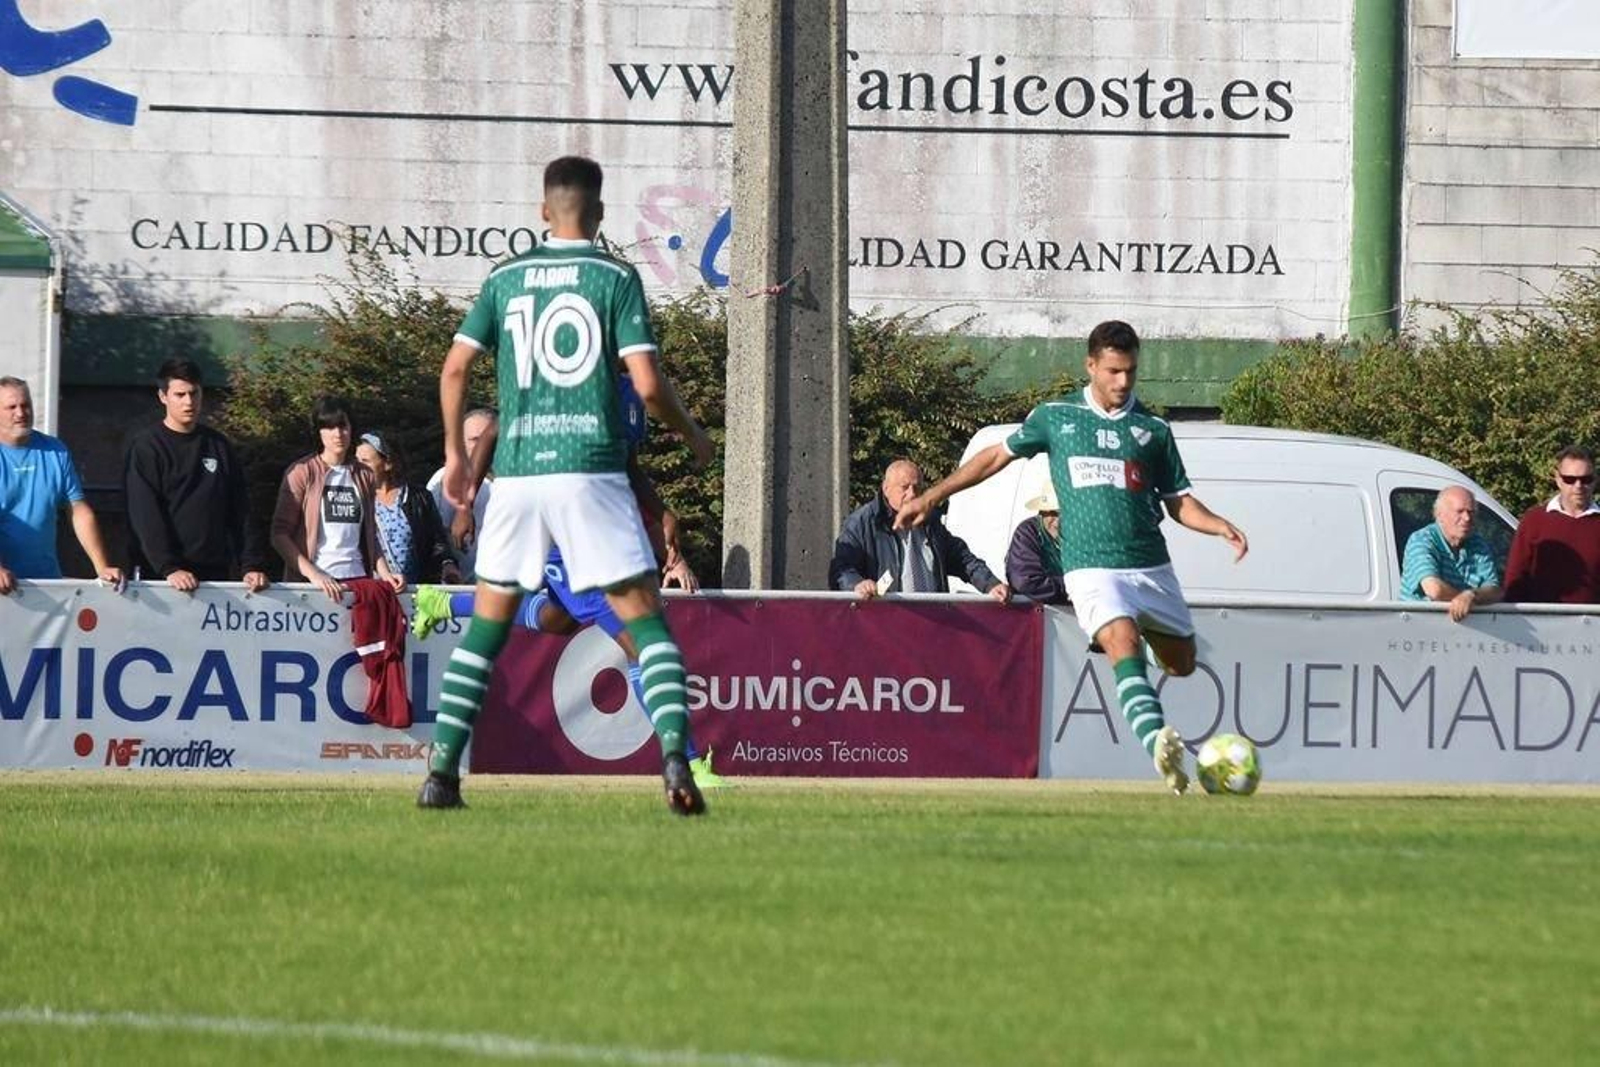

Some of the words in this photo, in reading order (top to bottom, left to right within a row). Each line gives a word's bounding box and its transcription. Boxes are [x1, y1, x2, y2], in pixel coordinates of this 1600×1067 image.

[131, 218, 333, 255] CALIDAD
[347, 225, 612, 259] FANDICOA
[980, 239, 1286, 277] GARANTIZADA
[504, 292, 602, 389] 10
[1095, 428, 1121, 449] 15
[332, 504, 356, 517] LOVE
[202, 602, 339, 633] Abrasivos
[1387, 640, 1449, 653] HOTEL
[1477, 641, 1600, 655] RESTAURAN
[1054, 658, 1119, 744] A
[140, 739, 235, 768] nordiflex
[732, 740, 823, 762] Abrasivos
[829, 739, 909, 763] Técnicos
